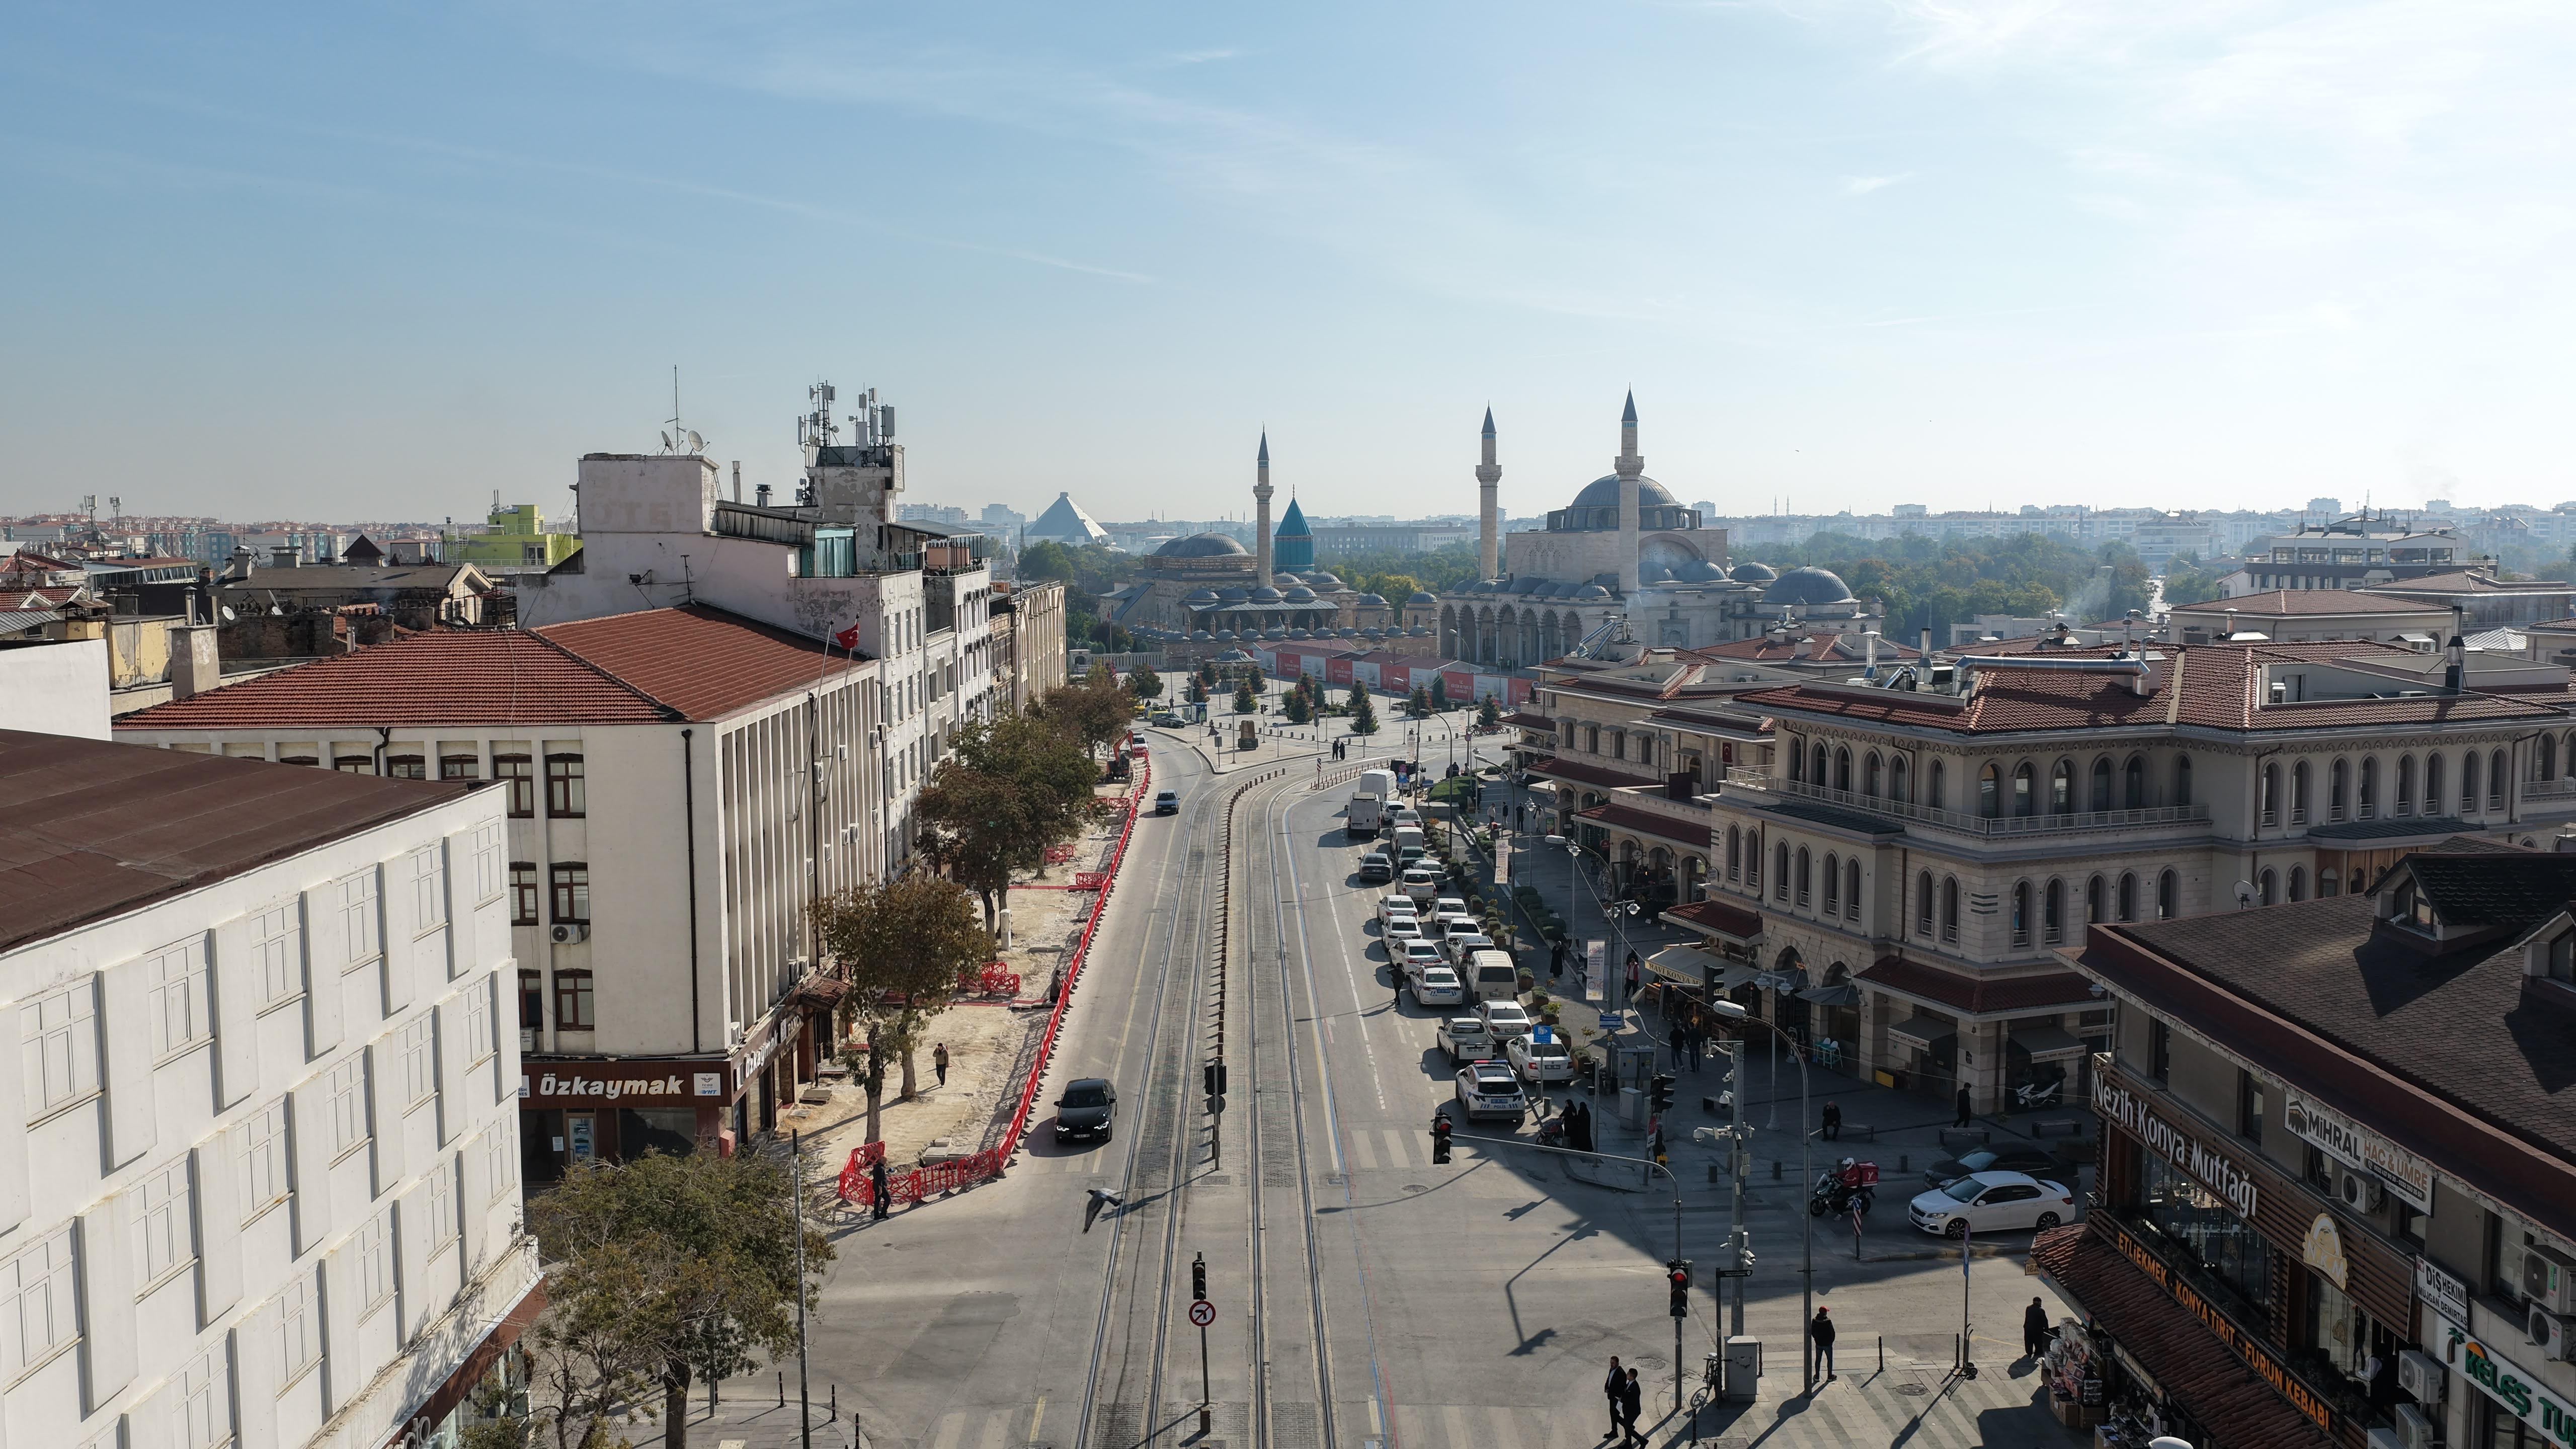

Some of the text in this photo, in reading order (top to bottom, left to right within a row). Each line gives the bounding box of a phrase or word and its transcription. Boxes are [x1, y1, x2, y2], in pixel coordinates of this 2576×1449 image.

[1667, 970, 1690, 984] KONYA
[744, 1030, 778, 1079] Özkaymak
[539, 1073, 684, 1099] Özkaymak
[2093, 1070, 2257, 1218] Nezih Konya Mutfağı
[2364, 1140, 2428, 1191] HAC & UMRE
[2418, 1284, 2439, 1307] MÜJGAN
[2426, 1264, 2466, 1306] DİŞ HEKİMİ
[2175, 1280, 2208, 1324] KONYA
[2209, 1309, 2234, 1345] TİRİT
[2245, 1340, 2282, 1391] FURUN
[2285, 1376, 2329, 1430] KEBABI
[2465, 1347, 2531, 1417] KELEŞ
